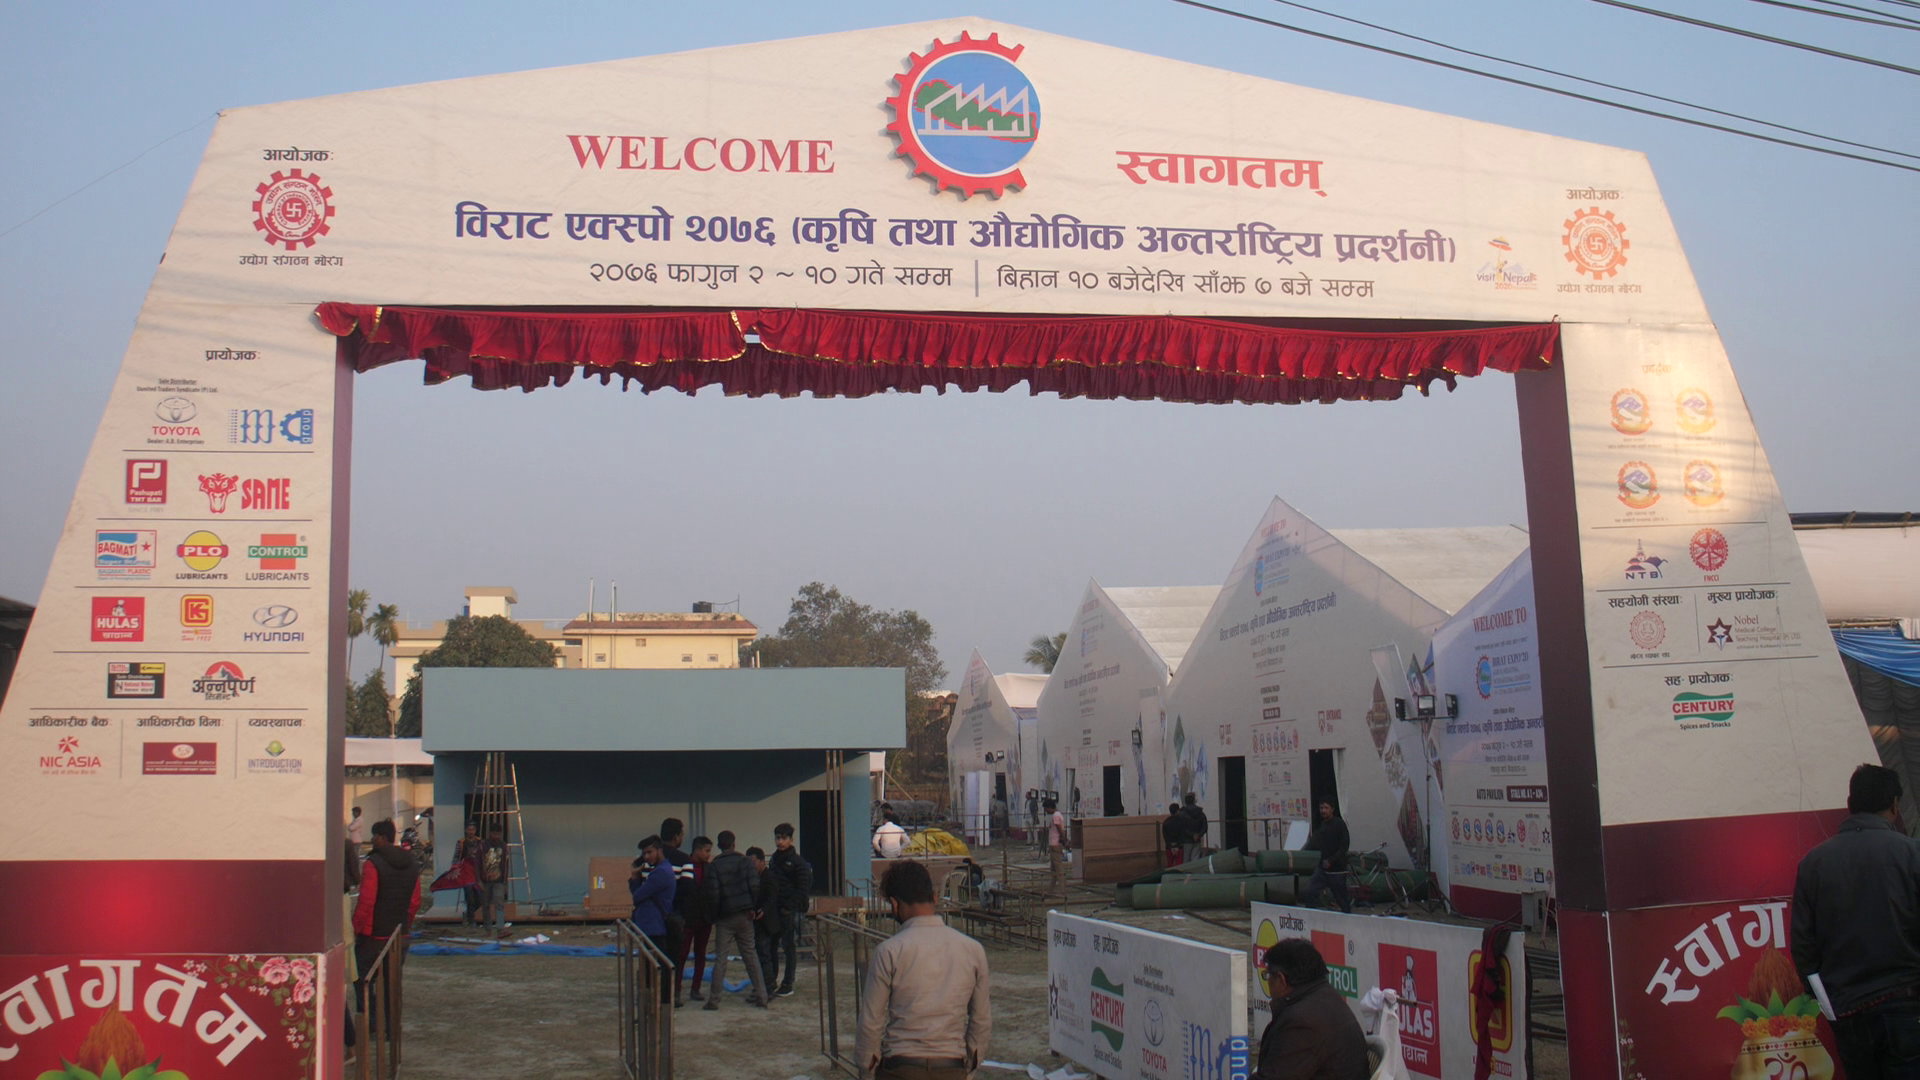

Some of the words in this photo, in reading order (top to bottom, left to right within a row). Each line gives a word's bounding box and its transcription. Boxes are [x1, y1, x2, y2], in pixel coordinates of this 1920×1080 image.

[263, 147, 334, 161] आयोजक:
[567, 135, 836, 173] WELCOME
[1116, 151, 1328, 197] स्वागतम्
[1566, 187, 1624, 200] आयोजक:
[455, 201, 552, 240] विराट
[565, 206, 674, 243] एक्स्पो
[685, 216, 776, 247] २०७६
[792, 208, 877, 253] (कृषि
[889, 218, 957, 246] तथा
[969, 211, 1126, 250] औद्योगिक
[1137, 221, 1323, 265] अन्तर्राष्ट्रिय
[1334, 229, 1456, 263] प्रदर्शनी)
[239, 254, 268, 266] उद्योग
[590, 263, 658, 284] २०७६
[667, 263, 739, 290] फागुन
[749, 267, 763, 284] २
[806, 266, 837, 285] १०
[846, 260, 885, 286] गते
[894, 267, 953, 287] सम्म
[997, 265, 1059, 290] बिहान
[1069, 271, 1099, 290] १०
[1107, 266, 1185, 293] बजेदेखि
[1255, 277, 1272, 294] ७
[1280, 272, 1313, 297] बजे
[1320, 278, 1374, 298] सम्म
[1476, 273, 1496, 282] visit
[1503, 272, 1534, 286] Nepal
[1495, 282, 1513, 290] 2020
[206, 347, 261, 362] प्रायोजक:
[152, 426, 201, 436] TOYOTA
[302, 409, 313, 443] group
[130, 489, 163, 497] Pashupati
[241, 478, 290, 510] SAME
[98, 542, 138, 555] BAGMATI
[183, 547, 222, 556] PLO
[249, 547, 307, 557] CONTROL
[246, 573, 309, 581] LUBRICANTS
[1608, 594, 1649, 608] सहयोगी
[1652, 594, 1683, 607] संस्था:
[1707, 592, 1732, 603] मुख्य
[1735, 588, 1778, 602] प्रायोजक:
[97, 617, 139, 629] HULAS
[1473, 610, 1514, 632] WELCOME
[1515, 606, 1527, 624] TO
[1734, 615, 1759, 625] Nobel
[1756, 625, 1777, 634] College
[243, 632, 305, 642] HYUNDAI
[1736, 635, 1759, 643] Teaching
[1688, 671, 1734, 686] प्रायोजक:
[1672, 699, 1735, 714] CENTURY
[1680, 723, 1698, 731] Spices
[1699, 721, 1710, 729] and
[1711, 720, 1731, 729] Snacks
[40, 756, 63, 768] NIC
[66, 756, 102, 768] ASIA
[248, 758, 303, 768] INTRODUCTION
[1476, 788, 1487, 801] AUTO
[1279, 913, 1306, 931] प्रायोजक:
[1645, 901, 1788, 1006] स्वाग
[1326, 966, 1357, 993] TROL
[1090, 990, 1125, 1029] CENTURY
[1398, 1003, 1434, 1039] ULAS
[1142, 1047, 1168, 1074] TOYOTA
[1496, 1060, 1512, 1077] GROUP
